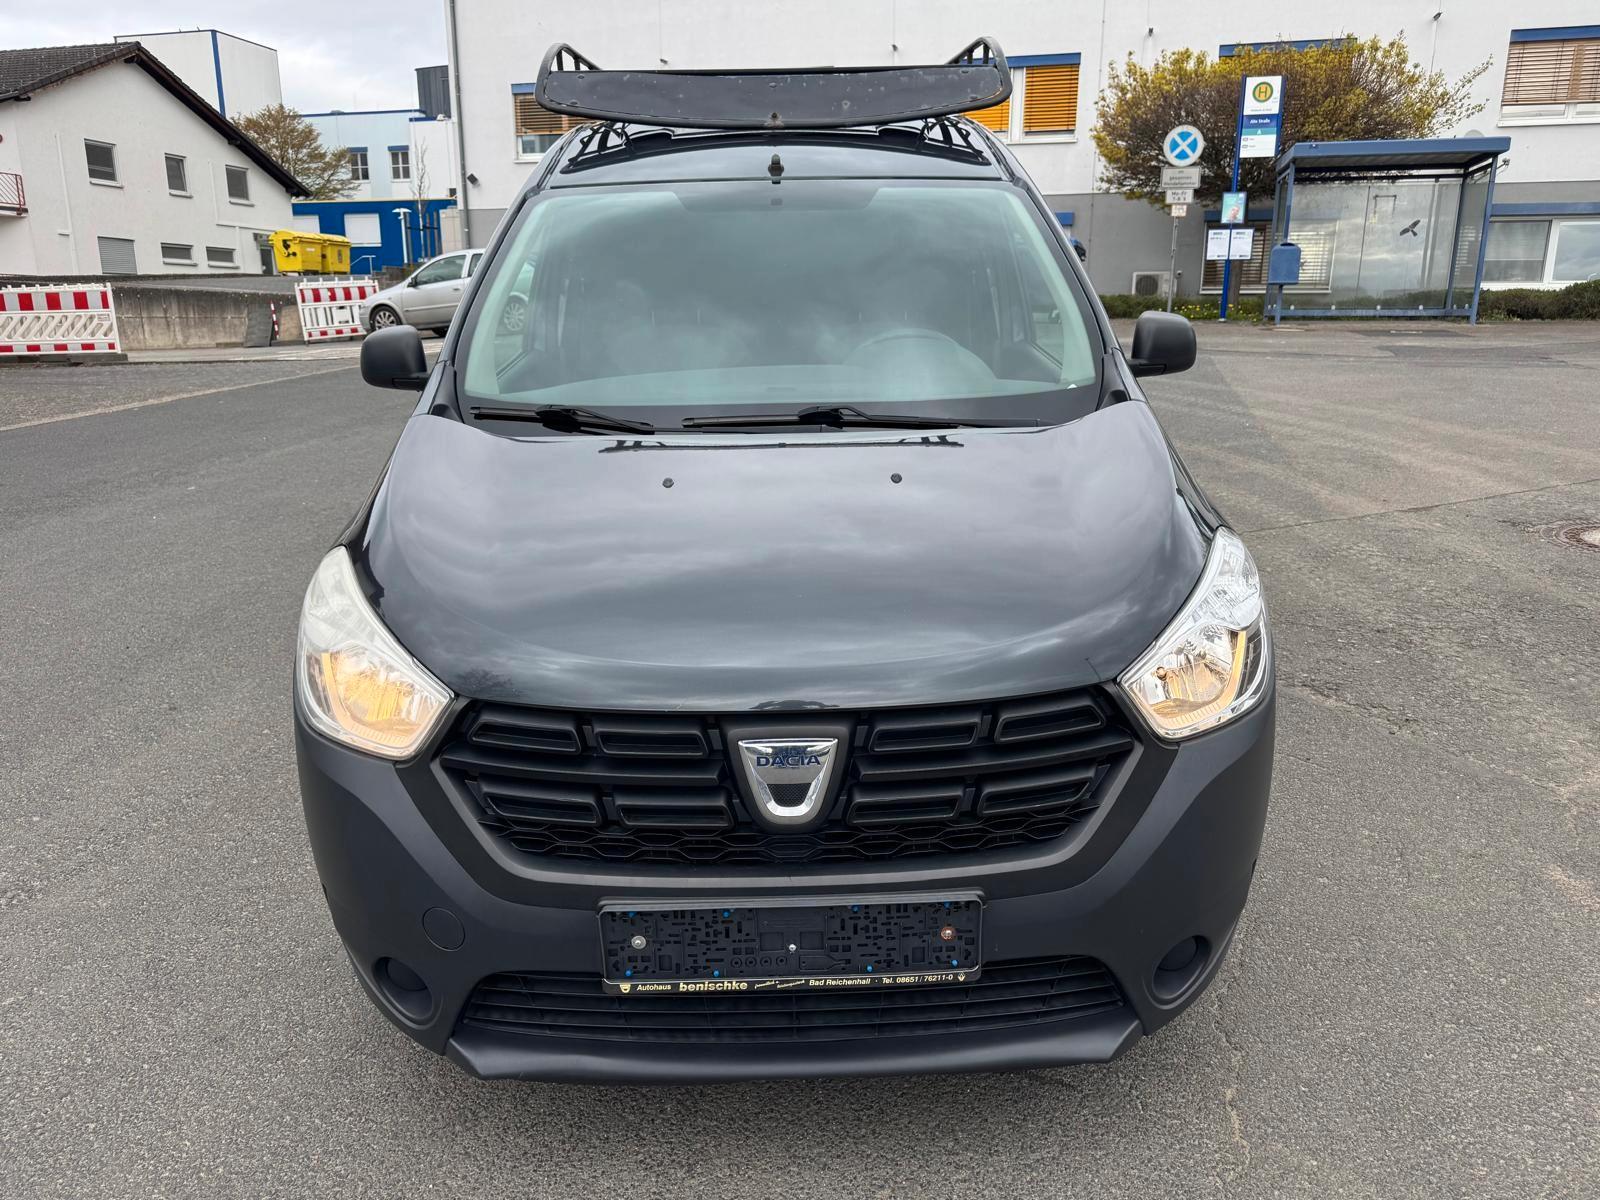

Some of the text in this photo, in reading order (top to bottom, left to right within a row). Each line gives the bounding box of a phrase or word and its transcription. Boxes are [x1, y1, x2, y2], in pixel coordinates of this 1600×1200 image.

[757, 755, 821, 767] DACIA
[637, 983, 672, 991] Autohaus
[679, 981, 748, 992] benischke
[826, 978, 871, 986] Reichenhall
[896, 975, 918, 983] 08651
